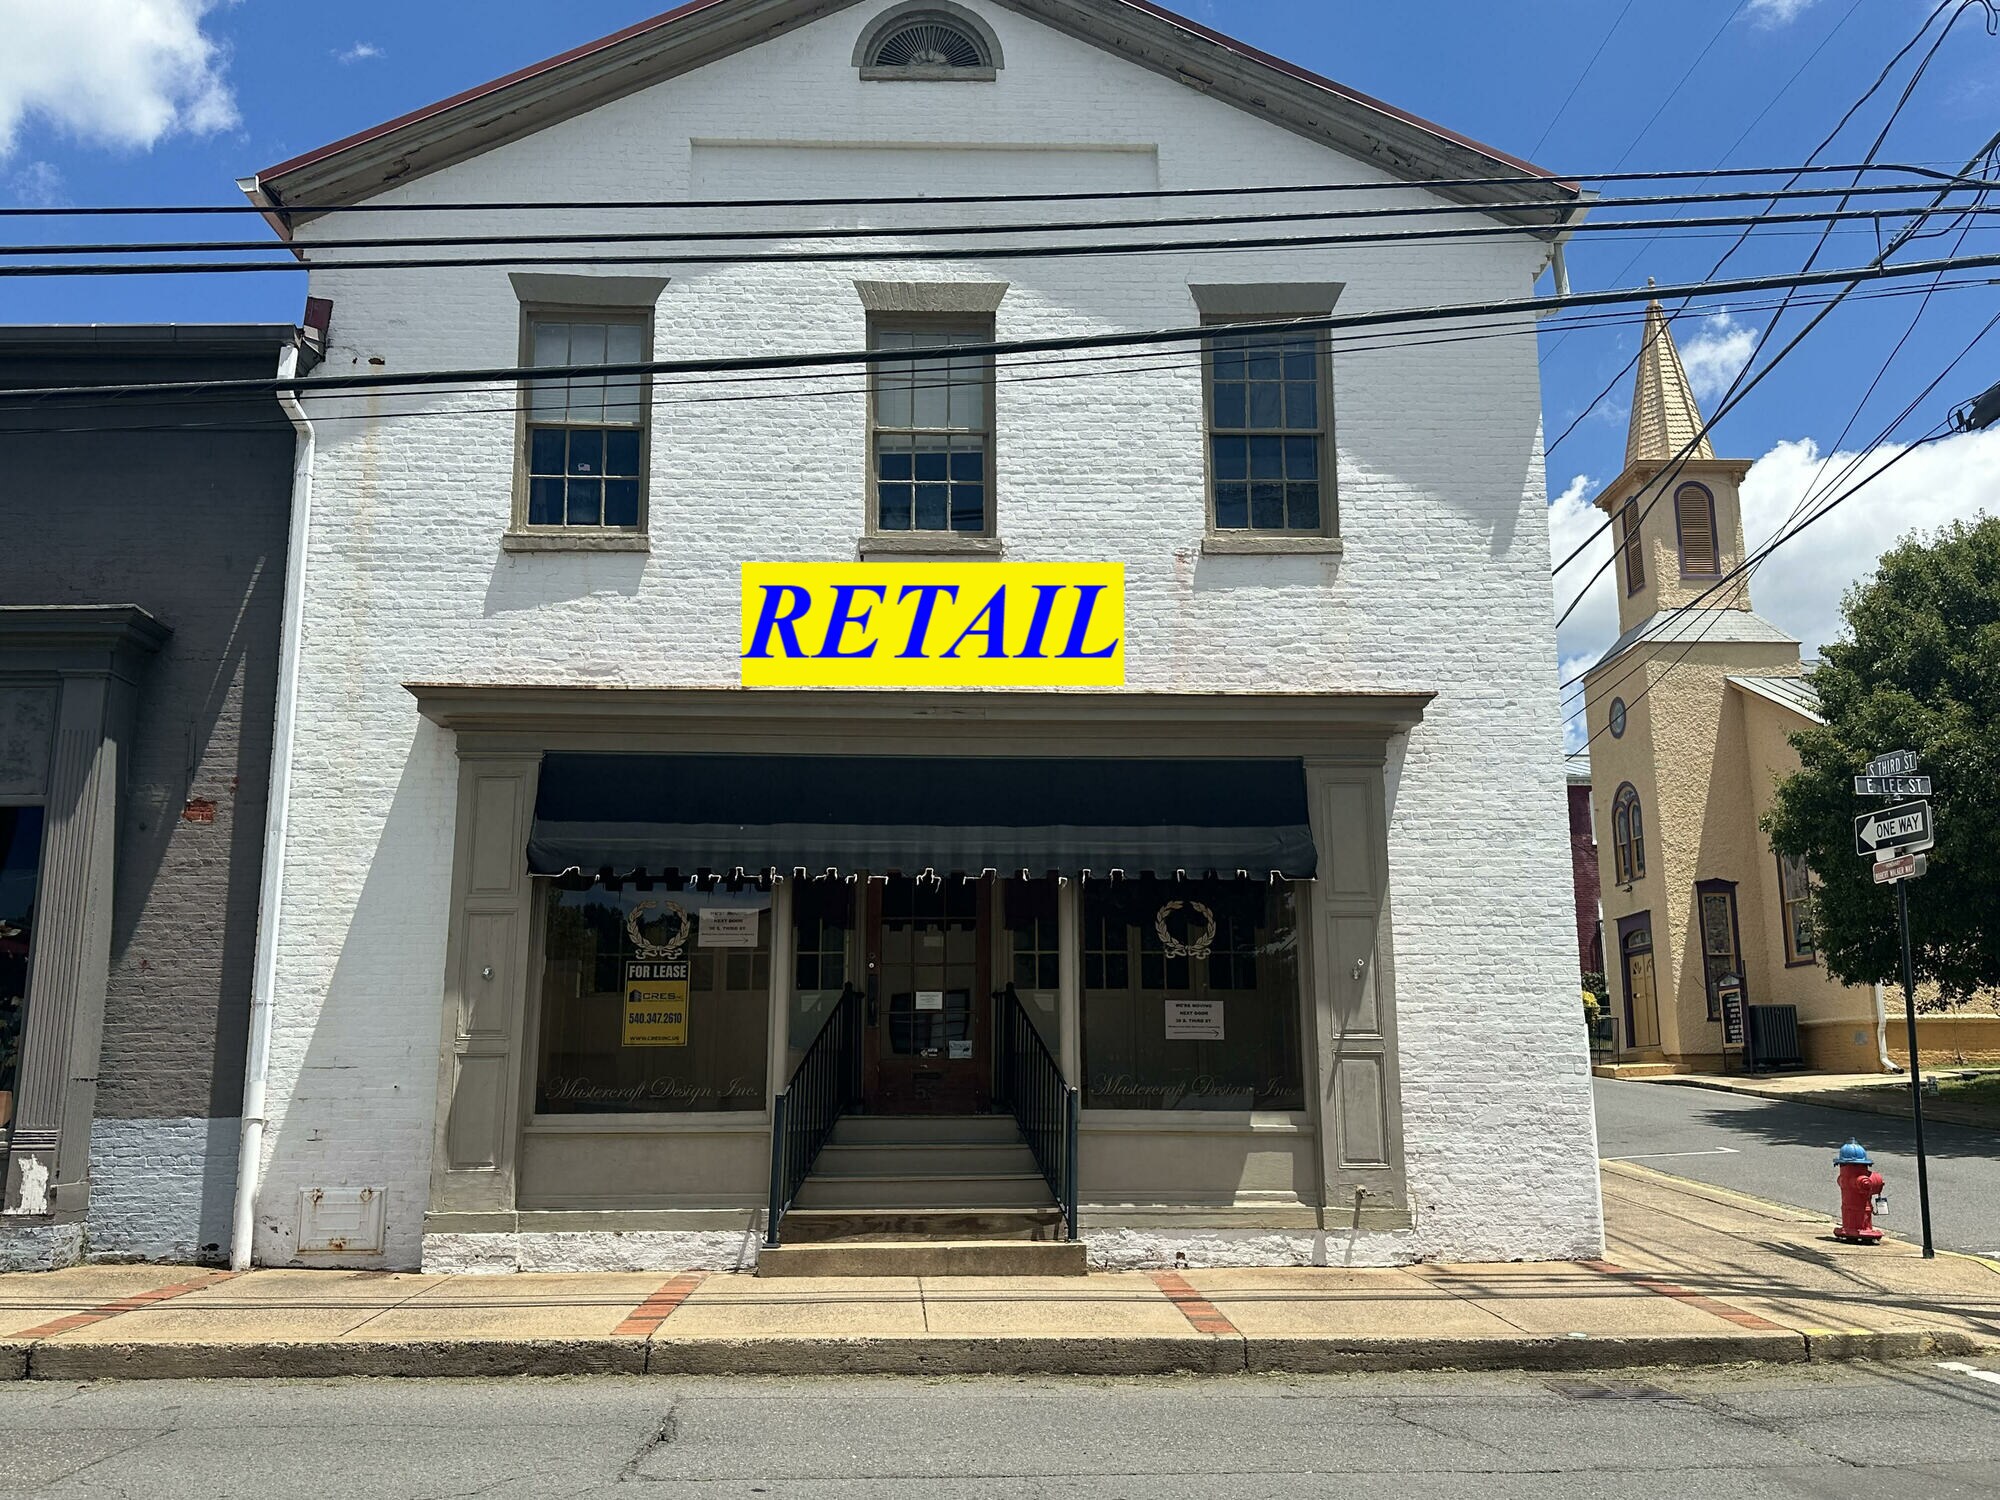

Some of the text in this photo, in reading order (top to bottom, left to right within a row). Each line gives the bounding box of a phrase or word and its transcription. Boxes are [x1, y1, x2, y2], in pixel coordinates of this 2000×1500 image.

[1877, 758, 1900, 776] THIRD
[1882, 778, 1903, 793] LEE
[1908, 778, 1925, 793] ST.
[1876, 814, 1920, 838] ONE WAY
[629, 965, 687, 978] FOR LEASE
[643, 992, 675, 1000] CRES
[628, 1012, 683, 1024] 540.347.2610
[545, 1076, 759, 1105] Mastercraft Design Inc.
[1090, 1073, 1186, 1098] Mastercraft
[1191, 1074, 1252, 1100] Design
